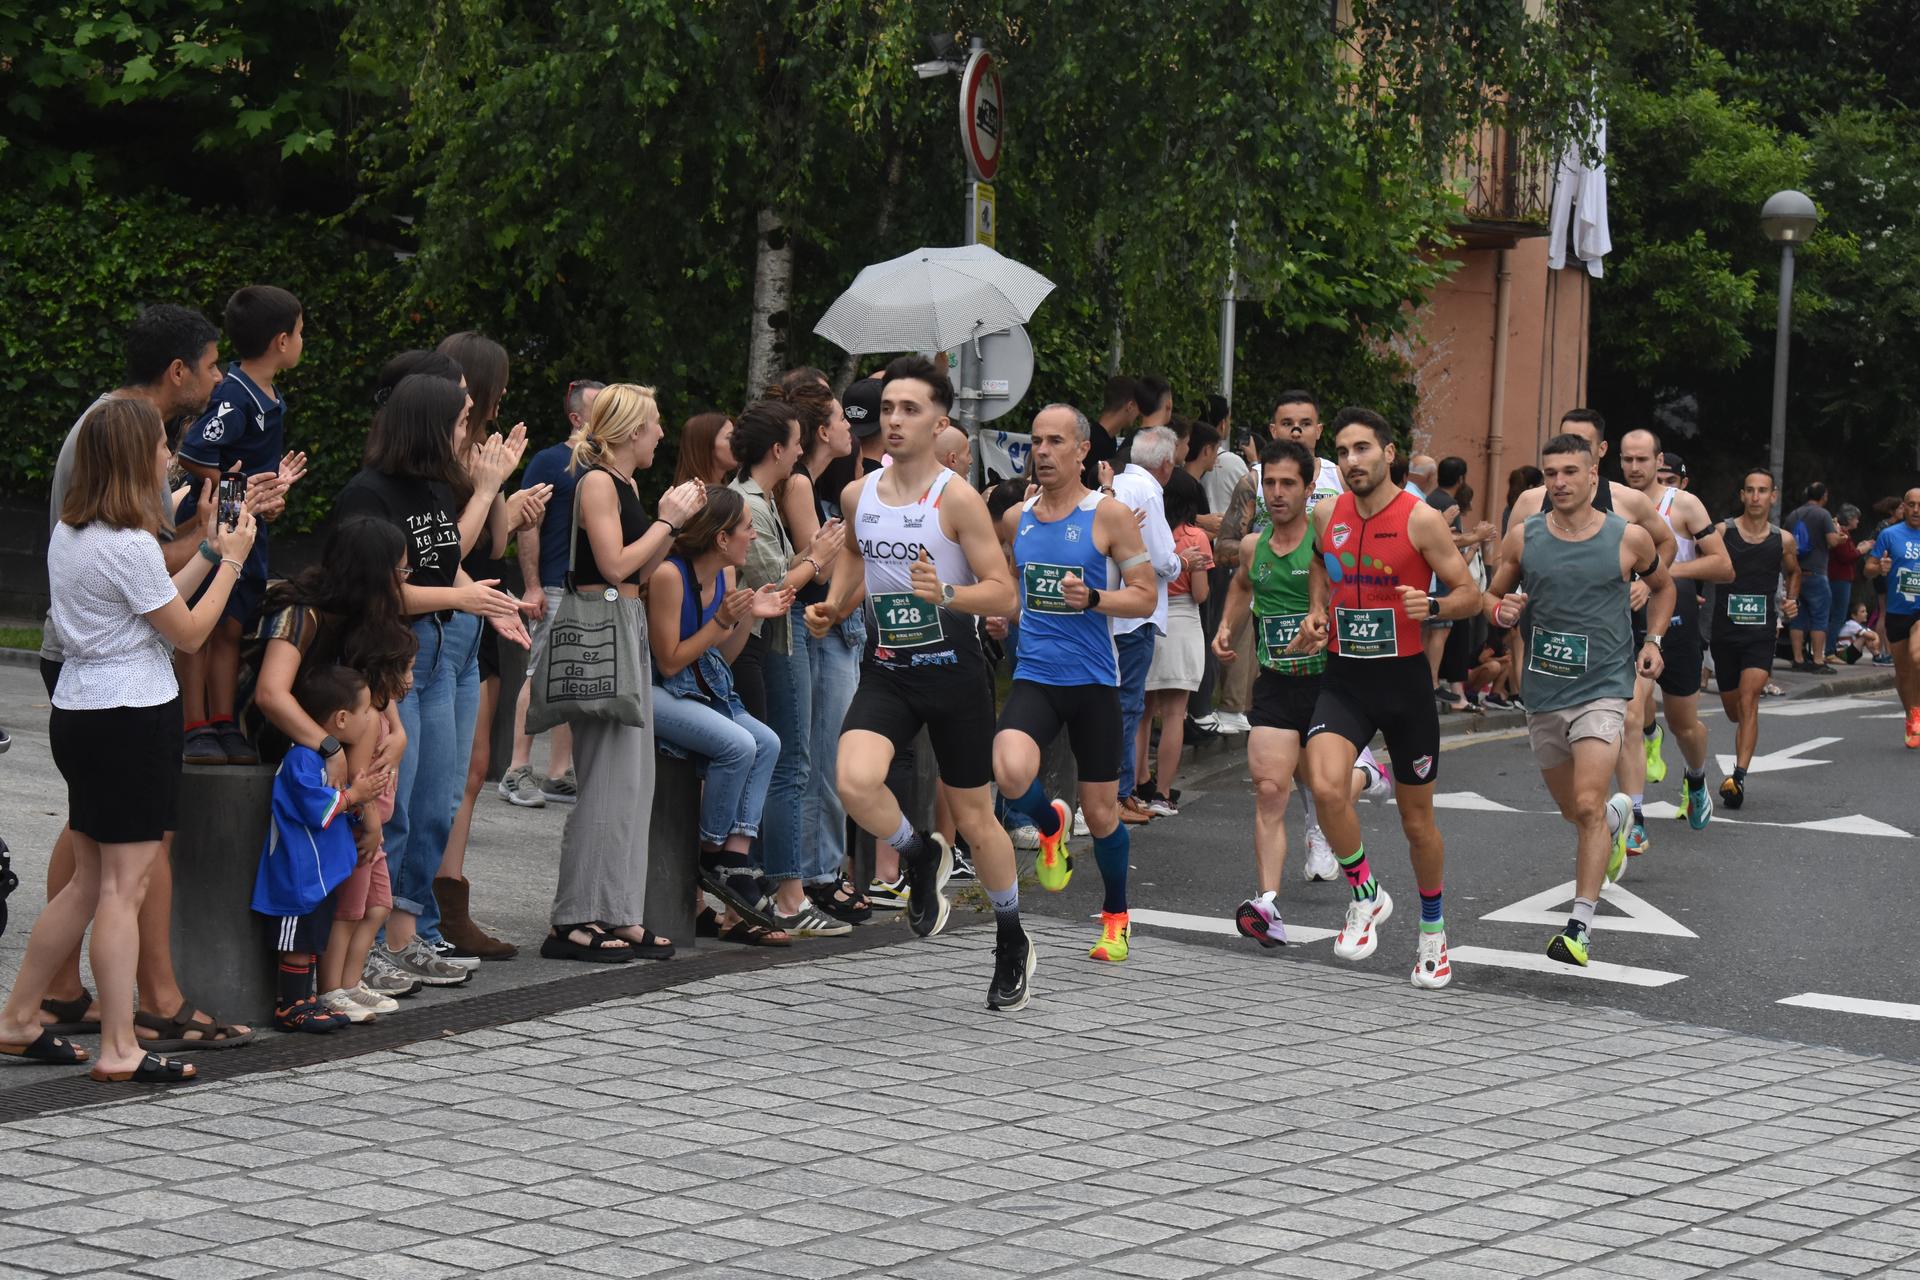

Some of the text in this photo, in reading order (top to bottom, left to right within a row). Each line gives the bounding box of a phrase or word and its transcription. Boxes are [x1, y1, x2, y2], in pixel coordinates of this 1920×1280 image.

[1904, 547, 1920, 559] SS
[1737, 603, 1758, 613] 144
[886, 607, 922, 625] 128
[1348, 623, 1380, 638] 247
[554, 631, 584, 644] inor
[582, 651, 600, 661] ez
[1543, 643, 1573, 660] 272
[564, 663, 584, 676] da
[561, 679, 611, 695] ilegala
